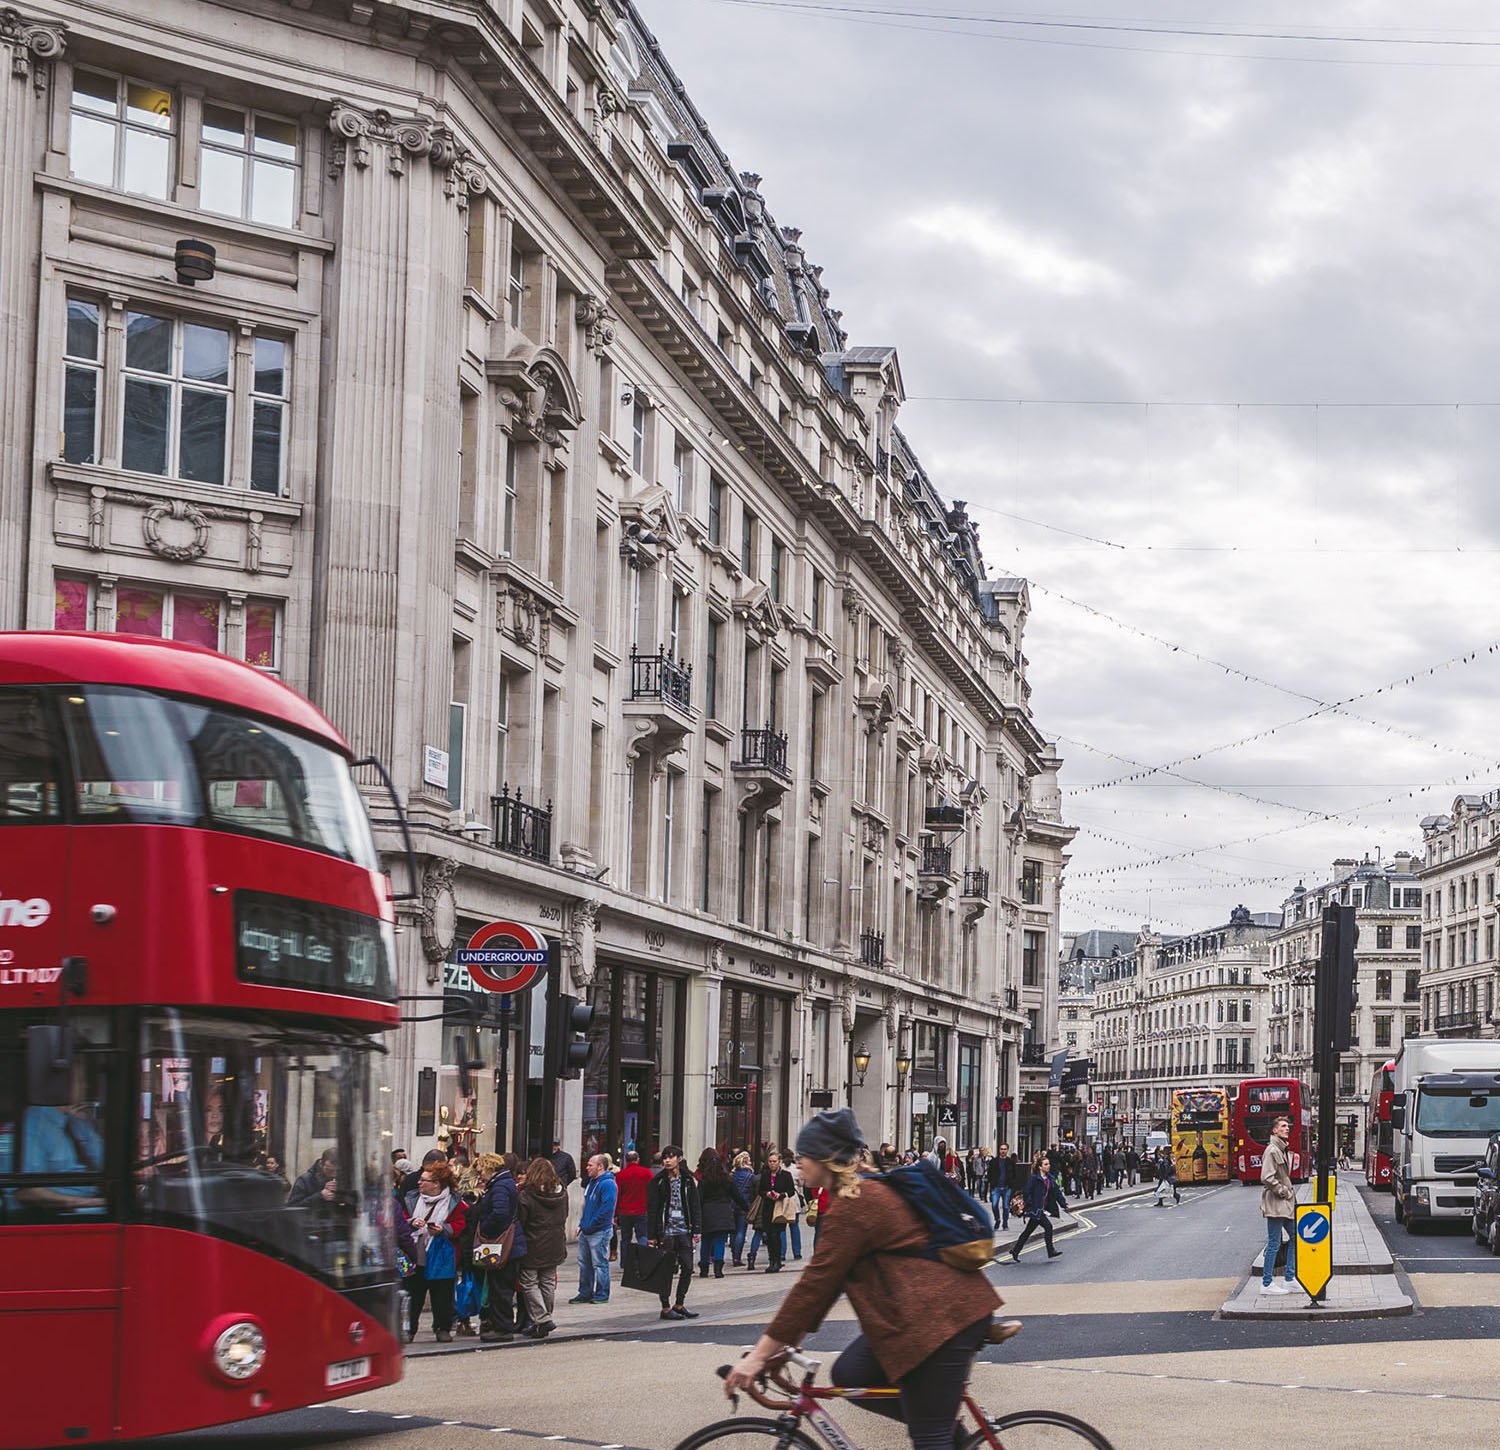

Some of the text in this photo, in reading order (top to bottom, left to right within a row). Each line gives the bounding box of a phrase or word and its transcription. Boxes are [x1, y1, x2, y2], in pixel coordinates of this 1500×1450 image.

[0, 898, 50, 927] ne
[645, 930, 665, 948] KIKO
[460, 952, 544, 962] UNDERGROUND
[715, 1092, 744, 1100] KIKO
[1250, 1105, 1261, 1113] 139
